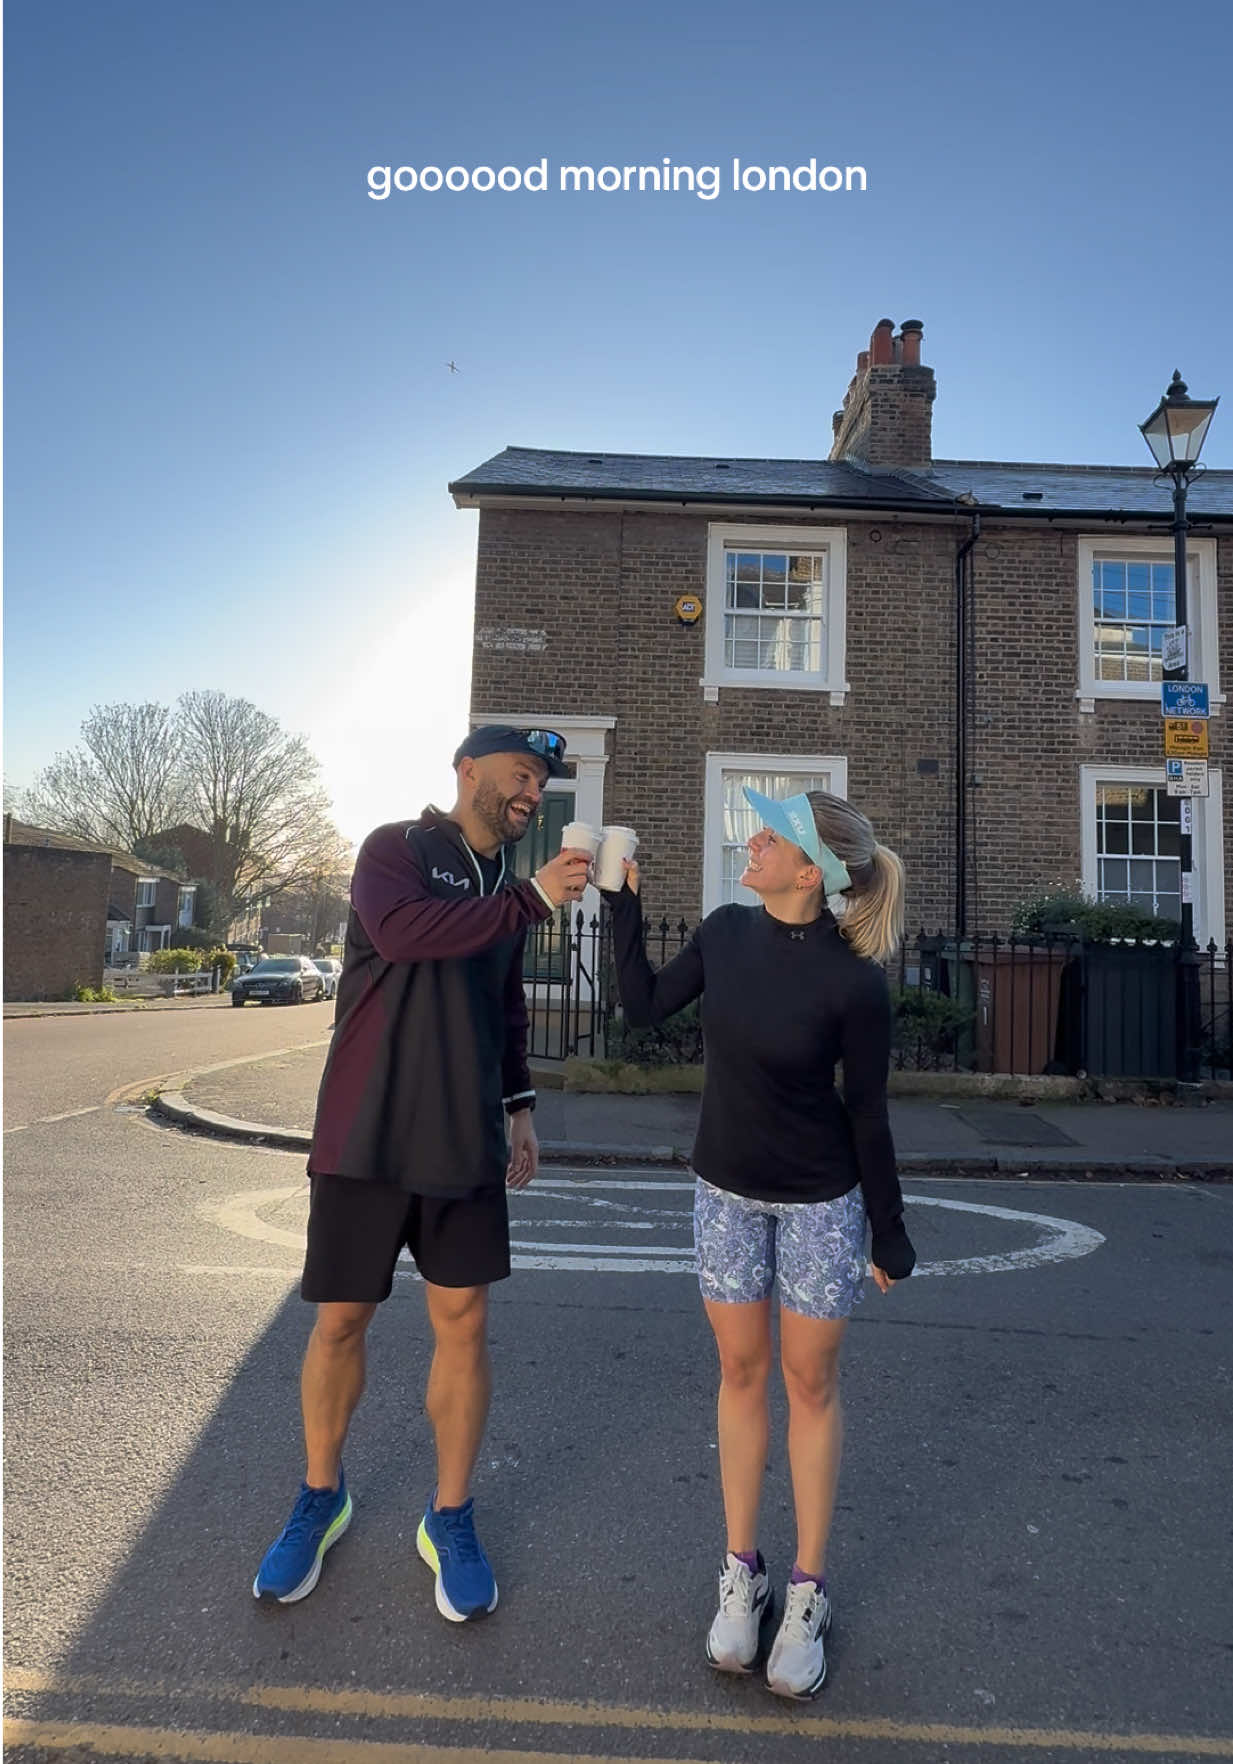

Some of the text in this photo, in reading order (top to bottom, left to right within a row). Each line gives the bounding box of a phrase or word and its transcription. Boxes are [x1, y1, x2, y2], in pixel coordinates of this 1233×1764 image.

[1167, 684, 1203, 693] LONDON
[1165, 706, 1207, 715] NETWORK
[1171, 761, 1181, 773] P
